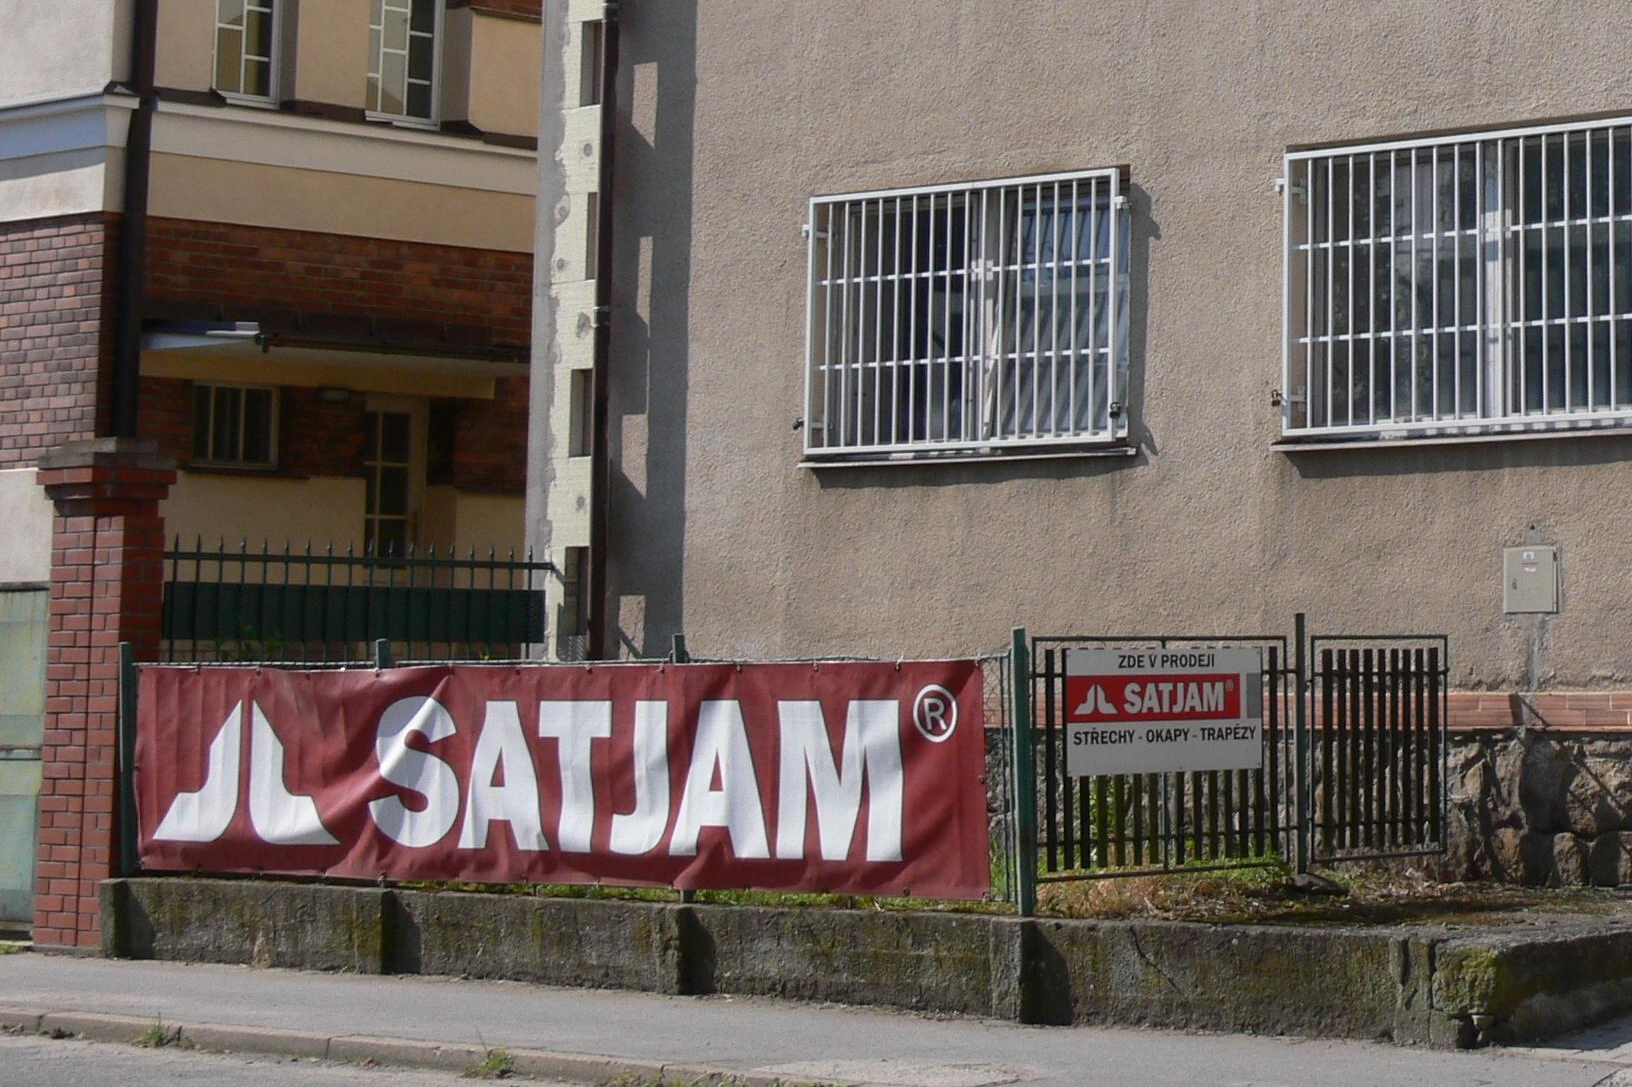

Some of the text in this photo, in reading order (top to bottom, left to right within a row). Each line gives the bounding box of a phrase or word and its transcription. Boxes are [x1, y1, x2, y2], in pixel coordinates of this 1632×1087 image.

[1118, 653, 1215, 669] ZDE V PRODEJI
[1073, 723, 1257, 746] STŘECHY OKAPY TRAPÉZY
